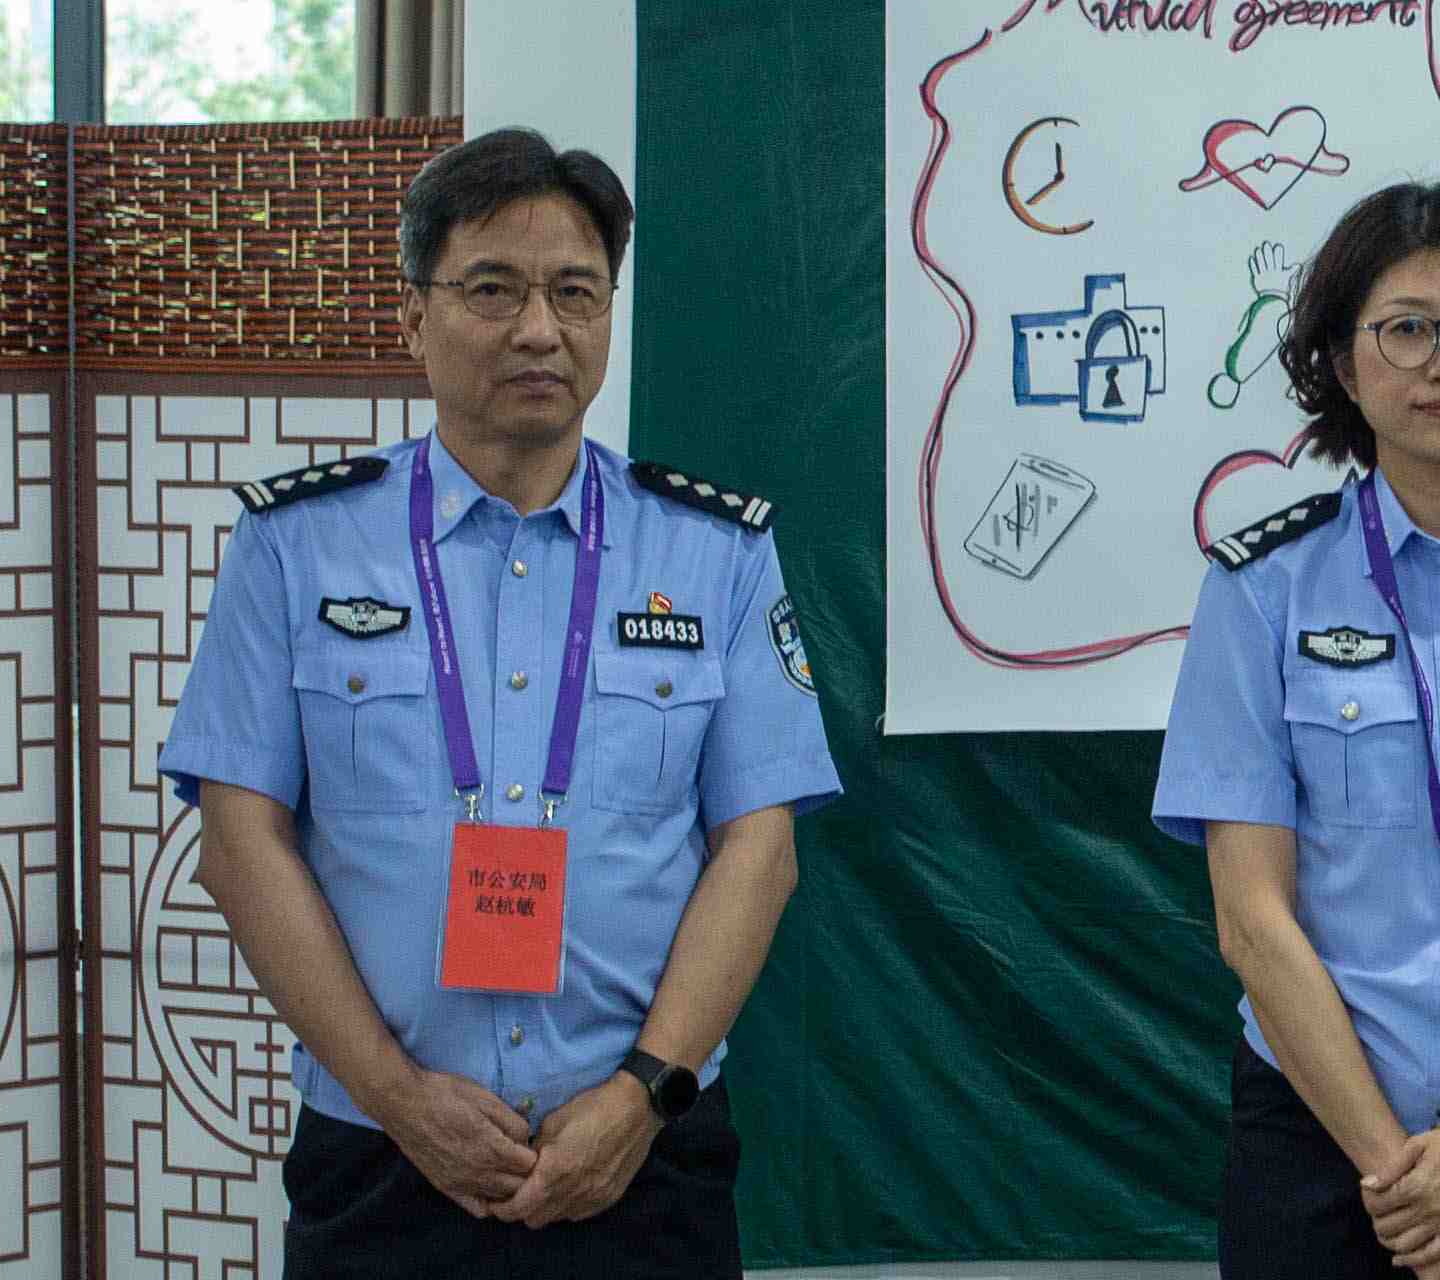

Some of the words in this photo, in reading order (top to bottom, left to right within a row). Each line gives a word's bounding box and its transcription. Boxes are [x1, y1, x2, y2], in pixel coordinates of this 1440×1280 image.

[624, 617, 700, 644] 018433
[464, 867, 547, 891] 市公安局
